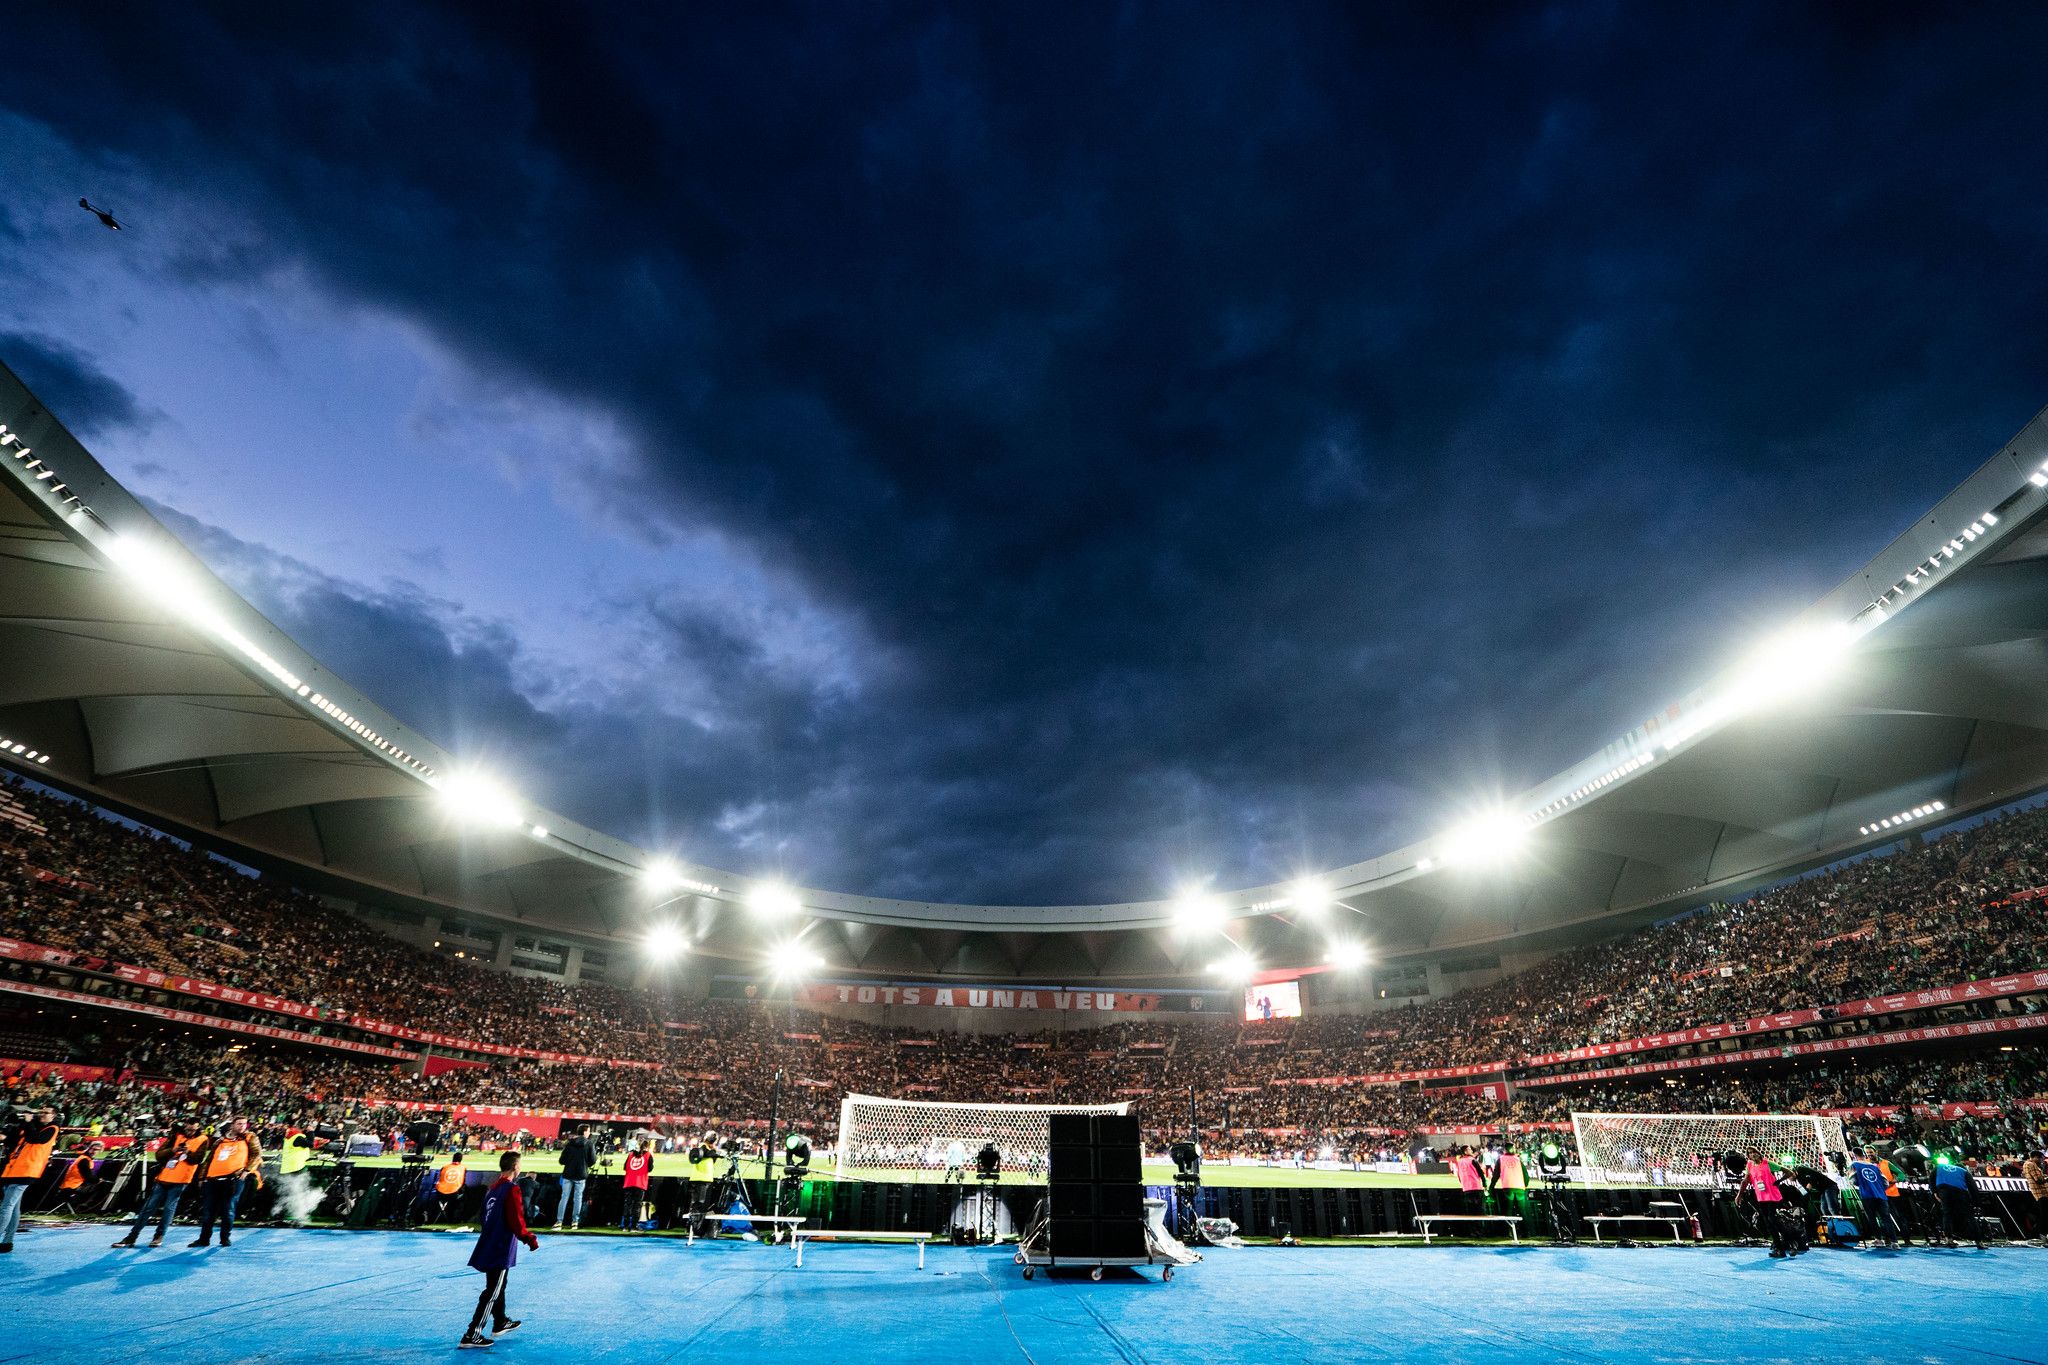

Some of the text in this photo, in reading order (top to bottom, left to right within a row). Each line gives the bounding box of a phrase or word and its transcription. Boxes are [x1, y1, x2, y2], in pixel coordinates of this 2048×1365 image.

[1990, 978, 2020, 987] finetwork
[836, 985, 1115, 1010] TOTS A UNA VEU
